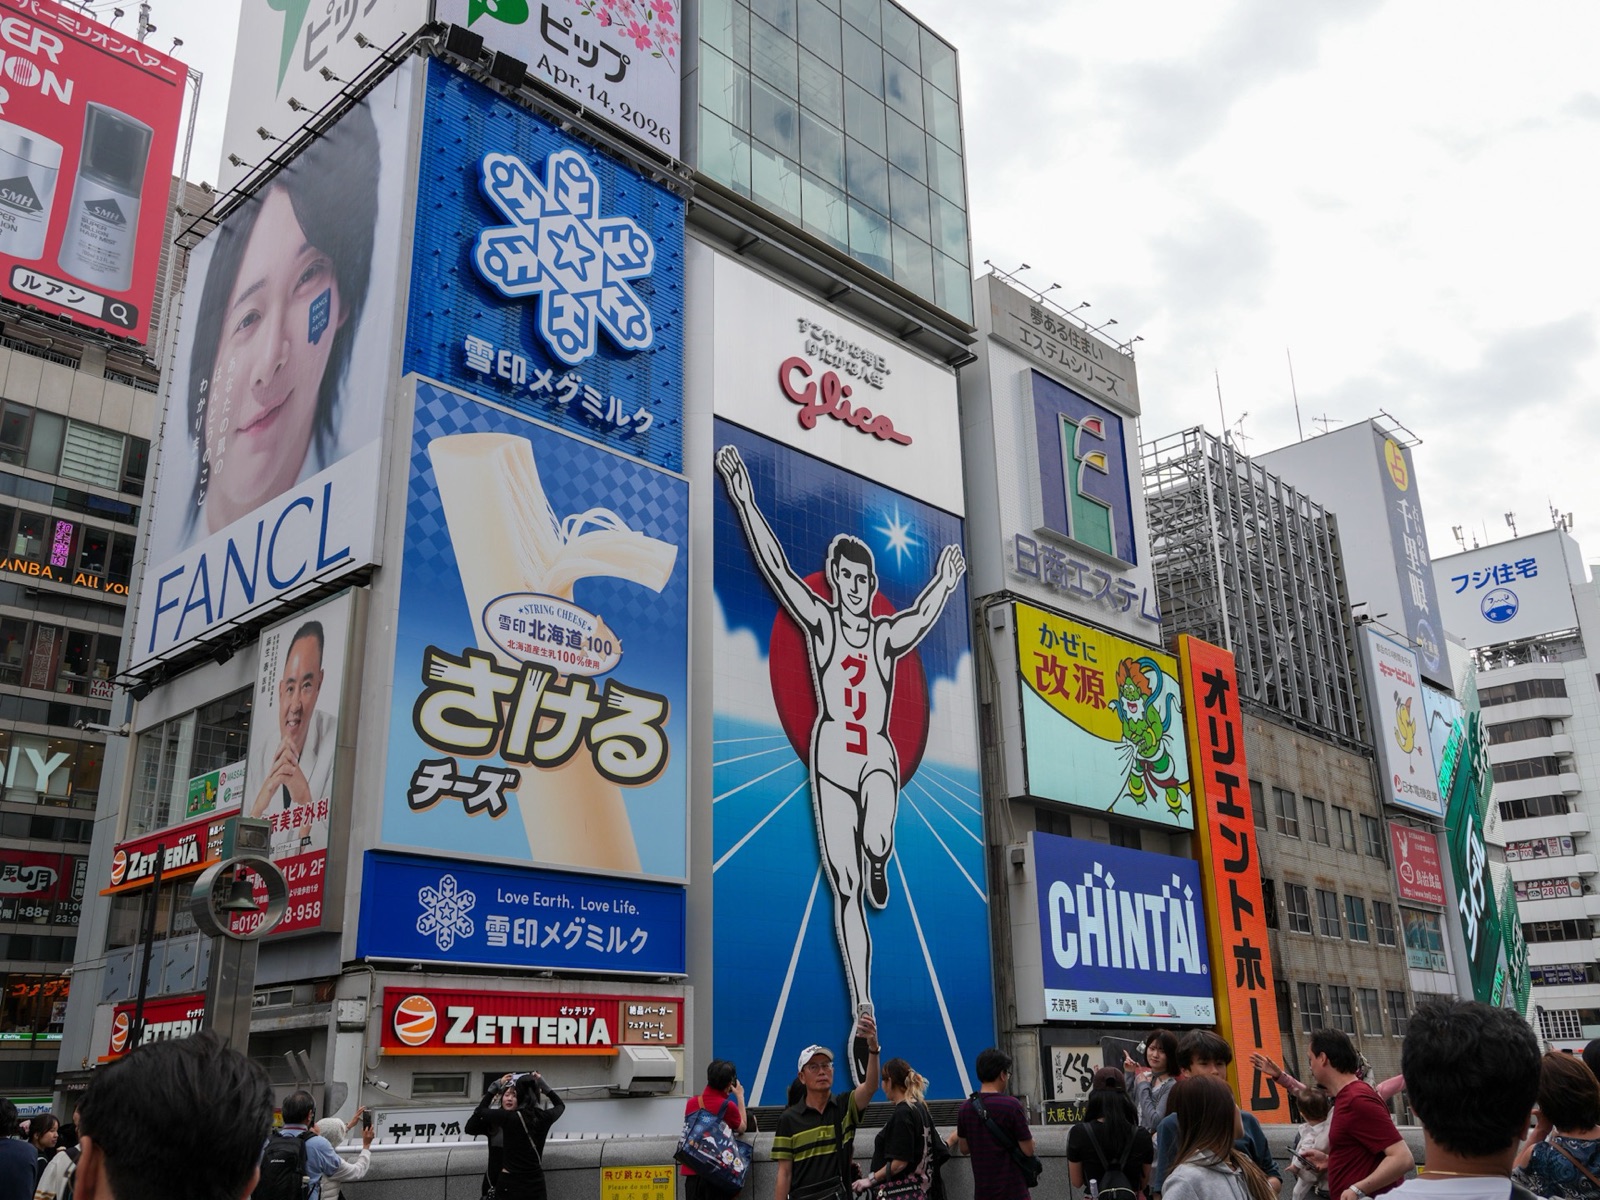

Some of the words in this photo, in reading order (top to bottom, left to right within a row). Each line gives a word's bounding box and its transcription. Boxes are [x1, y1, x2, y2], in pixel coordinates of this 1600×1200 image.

[0, 16, 64, 64] ER
[540, 3, 631, 83] ピップ
[537, 54, 582, 93] Apr.
[587, 83, 616, 115] 14,
[619, 102, 671, 146] 2026
[20, 274, 85, 304] ルアン
[1030, 305, 1104, 362] 夢ある住まい
[805, 339, 885, 390] ゆたかな人生
[1019, 326, 1119, 397] エステムシリーズ
[464, 334, 654, 434] 雪印メグミルク
[779, 356, 912, 446] Glico
[148, 481, 351, 653] FANCL
[1396, 497, 1430, 616] 千里眼
[1451, 557, 1538, 594] フジ住宅
[74, 573, 99, 589] All
[523, 604, 555, 616] STRING
[556, 607, 588, 630] CHEESE
[507, 639, 600, 670] 北海道産生乳100%使用
[1038, 622, 1098, 664] かぜに
[1033, 651, 1108, 710] 改源
[416, 650, 666, 781] さける
[841, 653, 868, 756] グリコ
[411, 759, 517, 815] チーズ
[262, 798, 329, 834] 京美容外科
[127, 842, 198, 881] ZETERIA
[309, 858, 326, 877] 2F
[497, 888, 529, 905] Love
[533, 891, 575, 909] Earth.
[580, 897, 611, 913] Love
[613, 899, 640, 915] Life.
[1202, 668, 1280, 1111] オリエントホーム
[55, 914, 81, 924] 23:0
[280, 901, 321, 925] 8-958
[485, 915, 649, 955] 雪印メグミルク
[560, 1006, 596, 1016] ゼッテリア
[628, 1005, 673, 1017] 絶品バーガー
[1051, 998, 1079, 1013] 天気予報
[444, 1006, 612, 1046] ZETTERIA
[628, 1022, 664, 1030] フェアトレード
[643, 1031, 673, 1040] コーヒー
[604, 1170, 672, 1180] 飛び跳ねないで
